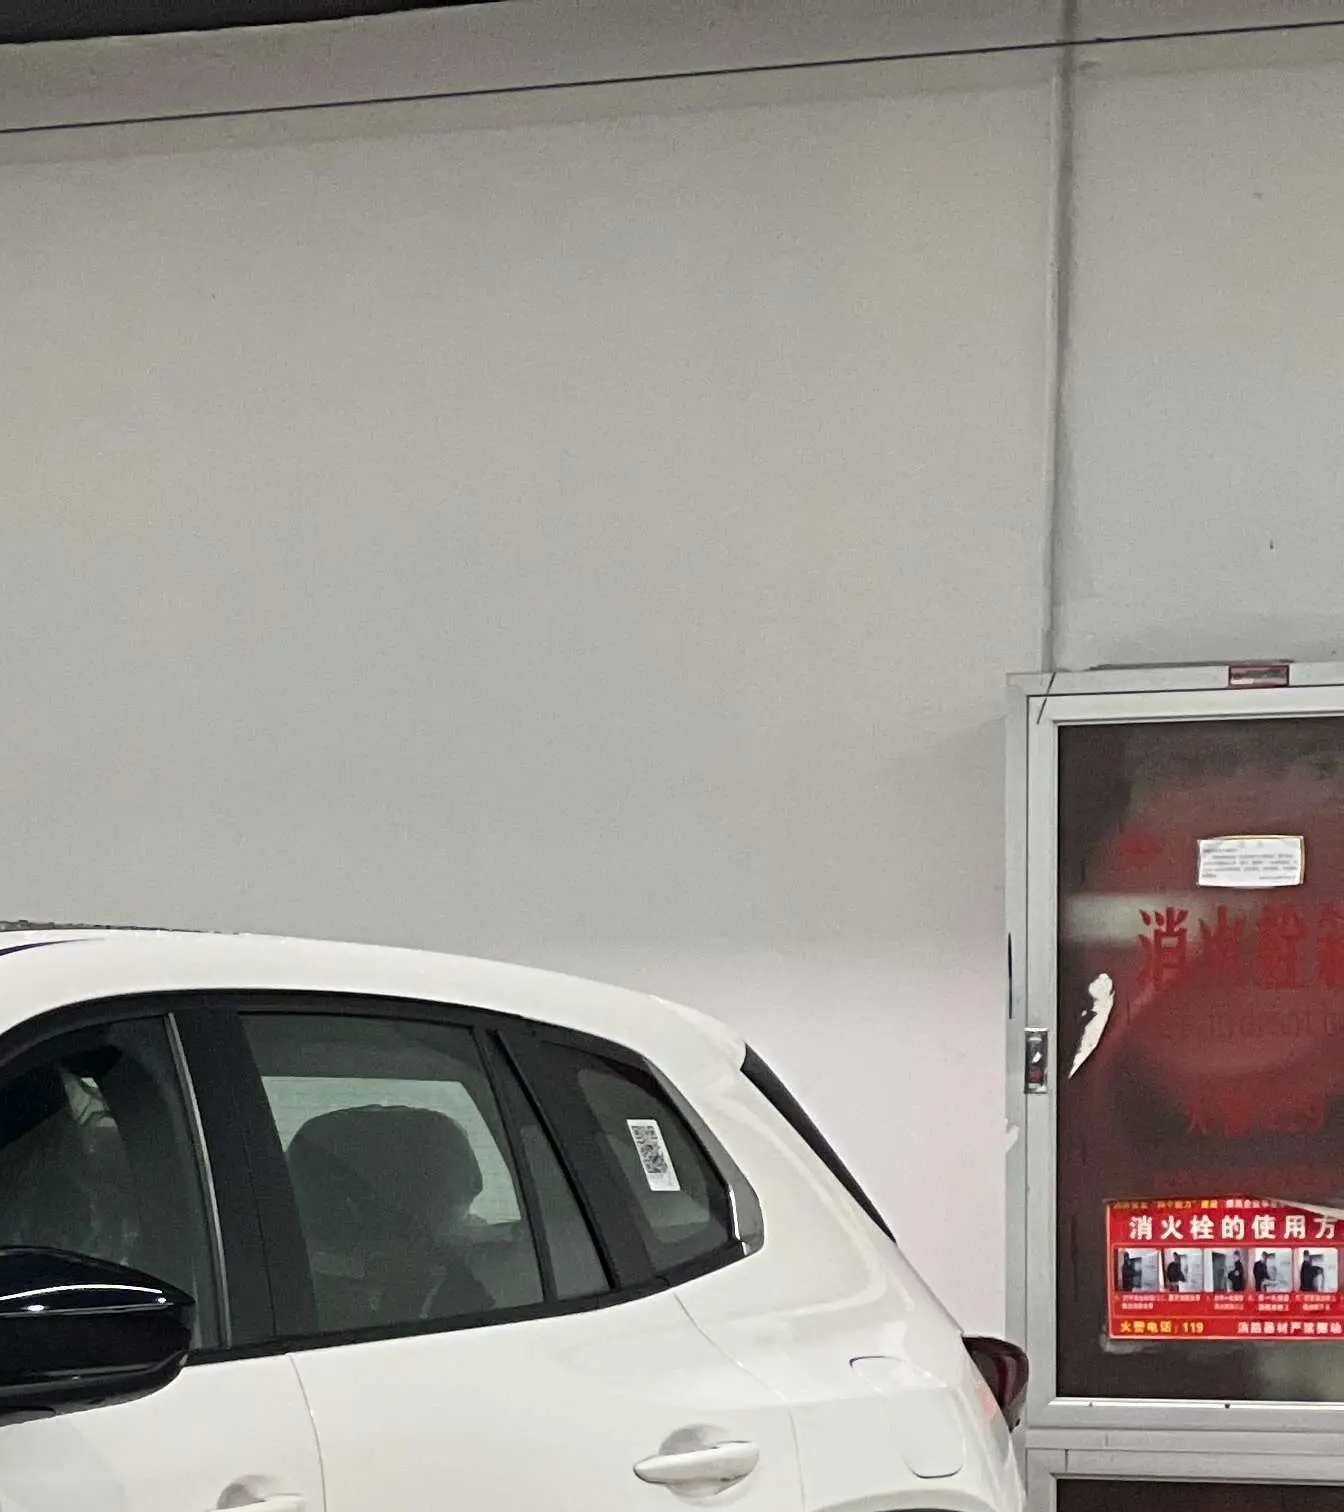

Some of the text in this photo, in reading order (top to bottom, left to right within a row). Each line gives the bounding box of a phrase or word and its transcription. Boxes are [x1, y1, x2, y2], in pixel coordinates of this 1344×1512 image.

[1128, 1214, 1336, 1241] 消火栓的使用方
